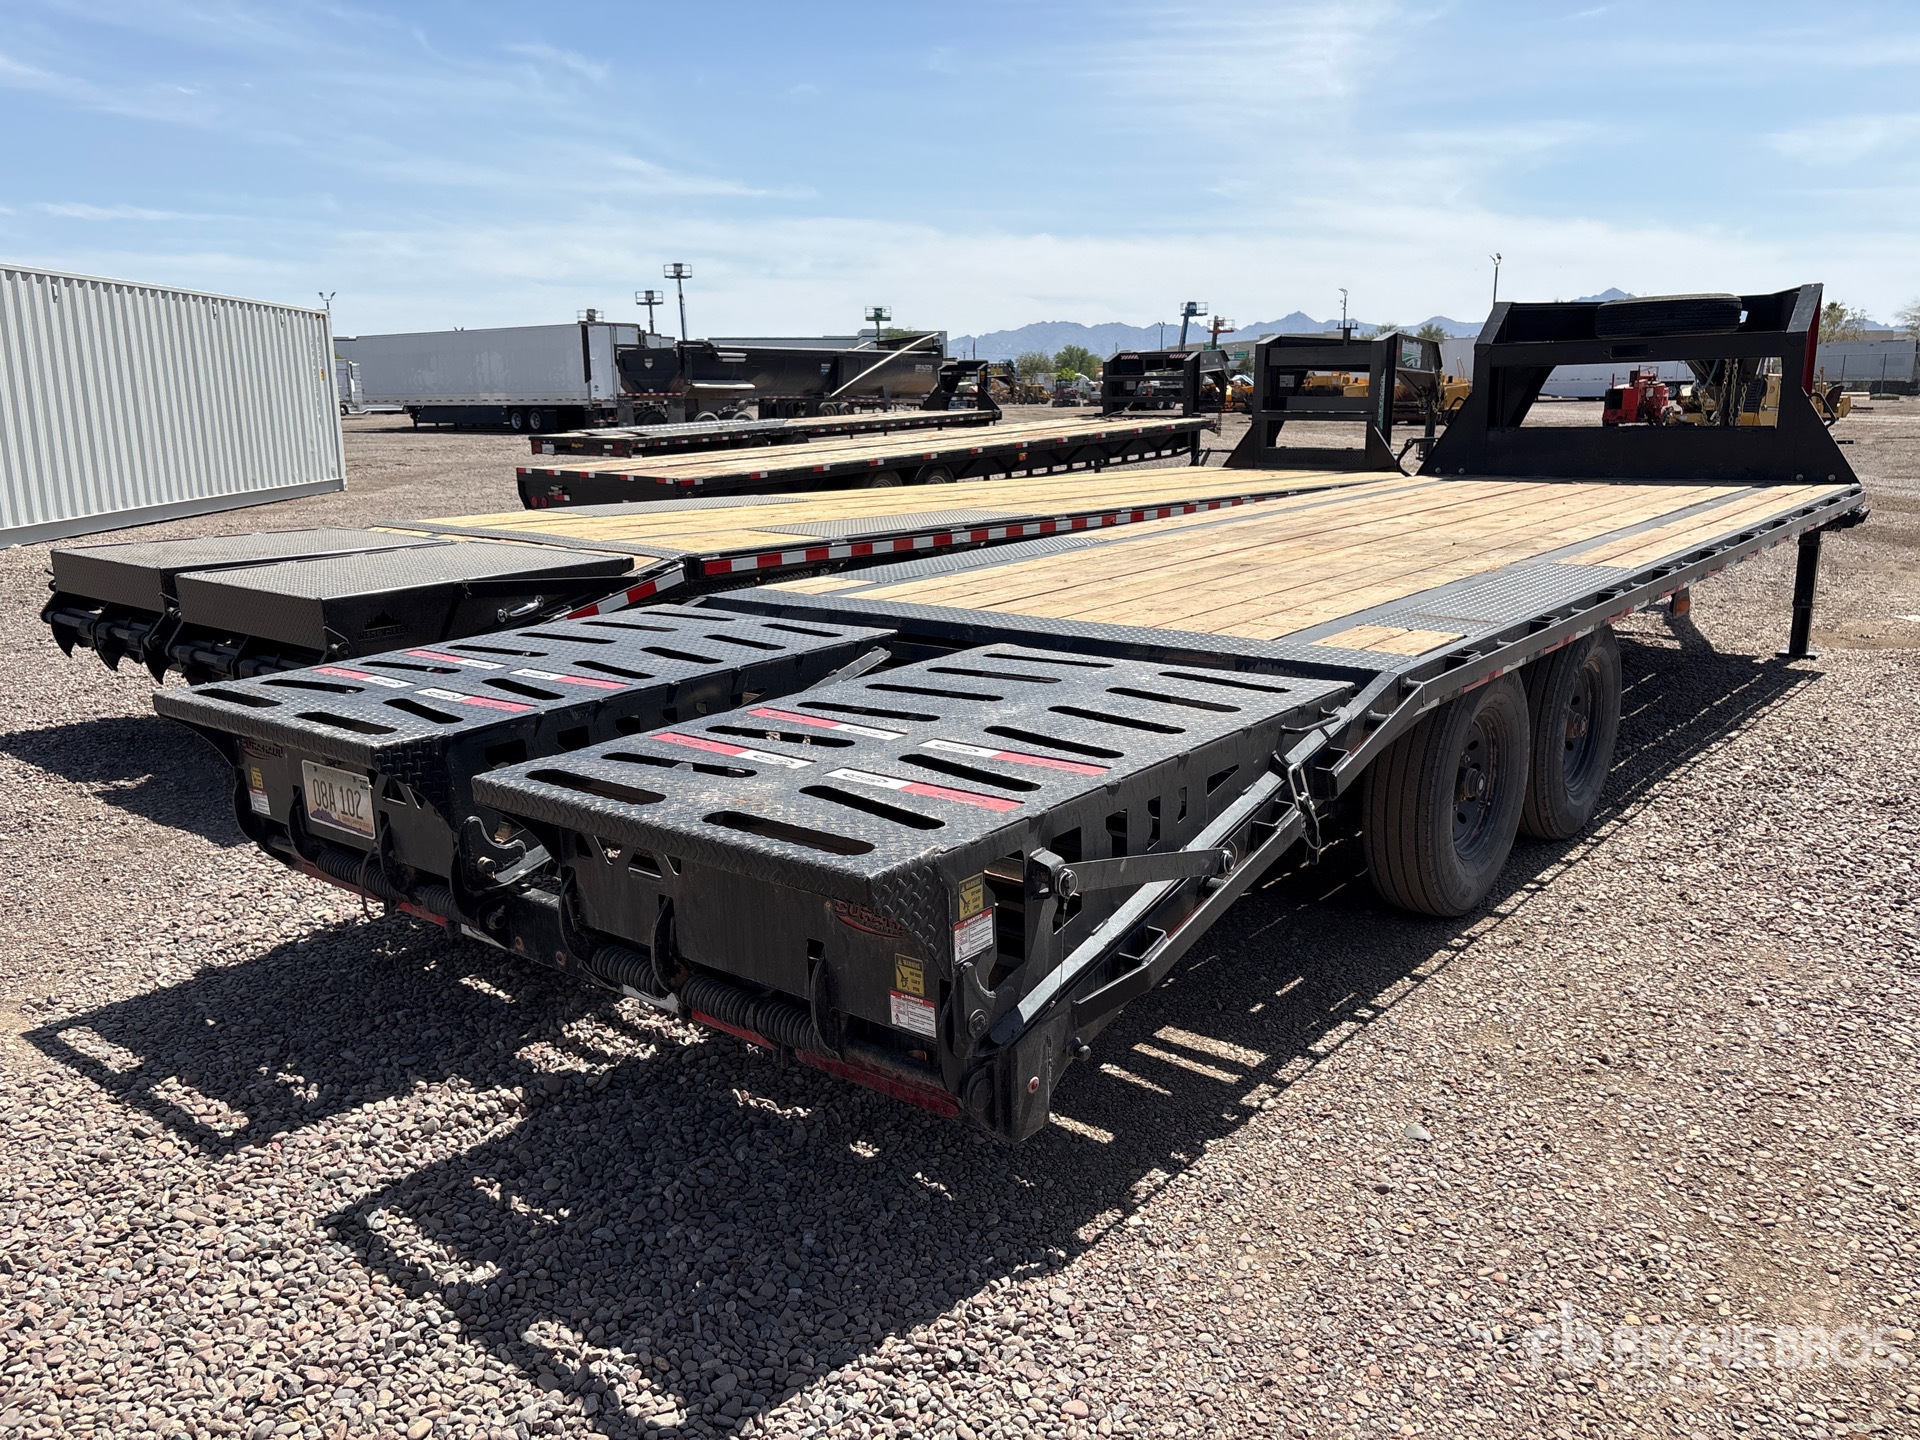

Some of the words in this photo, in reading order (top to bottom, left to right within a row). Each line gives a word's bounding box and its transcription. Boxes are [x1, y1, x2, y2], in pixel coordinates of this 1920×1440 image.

[381, 624, 409, 636] VALLEY
[312, 778, 337, 813] 08A
[339, 785, 364, 821] 102
